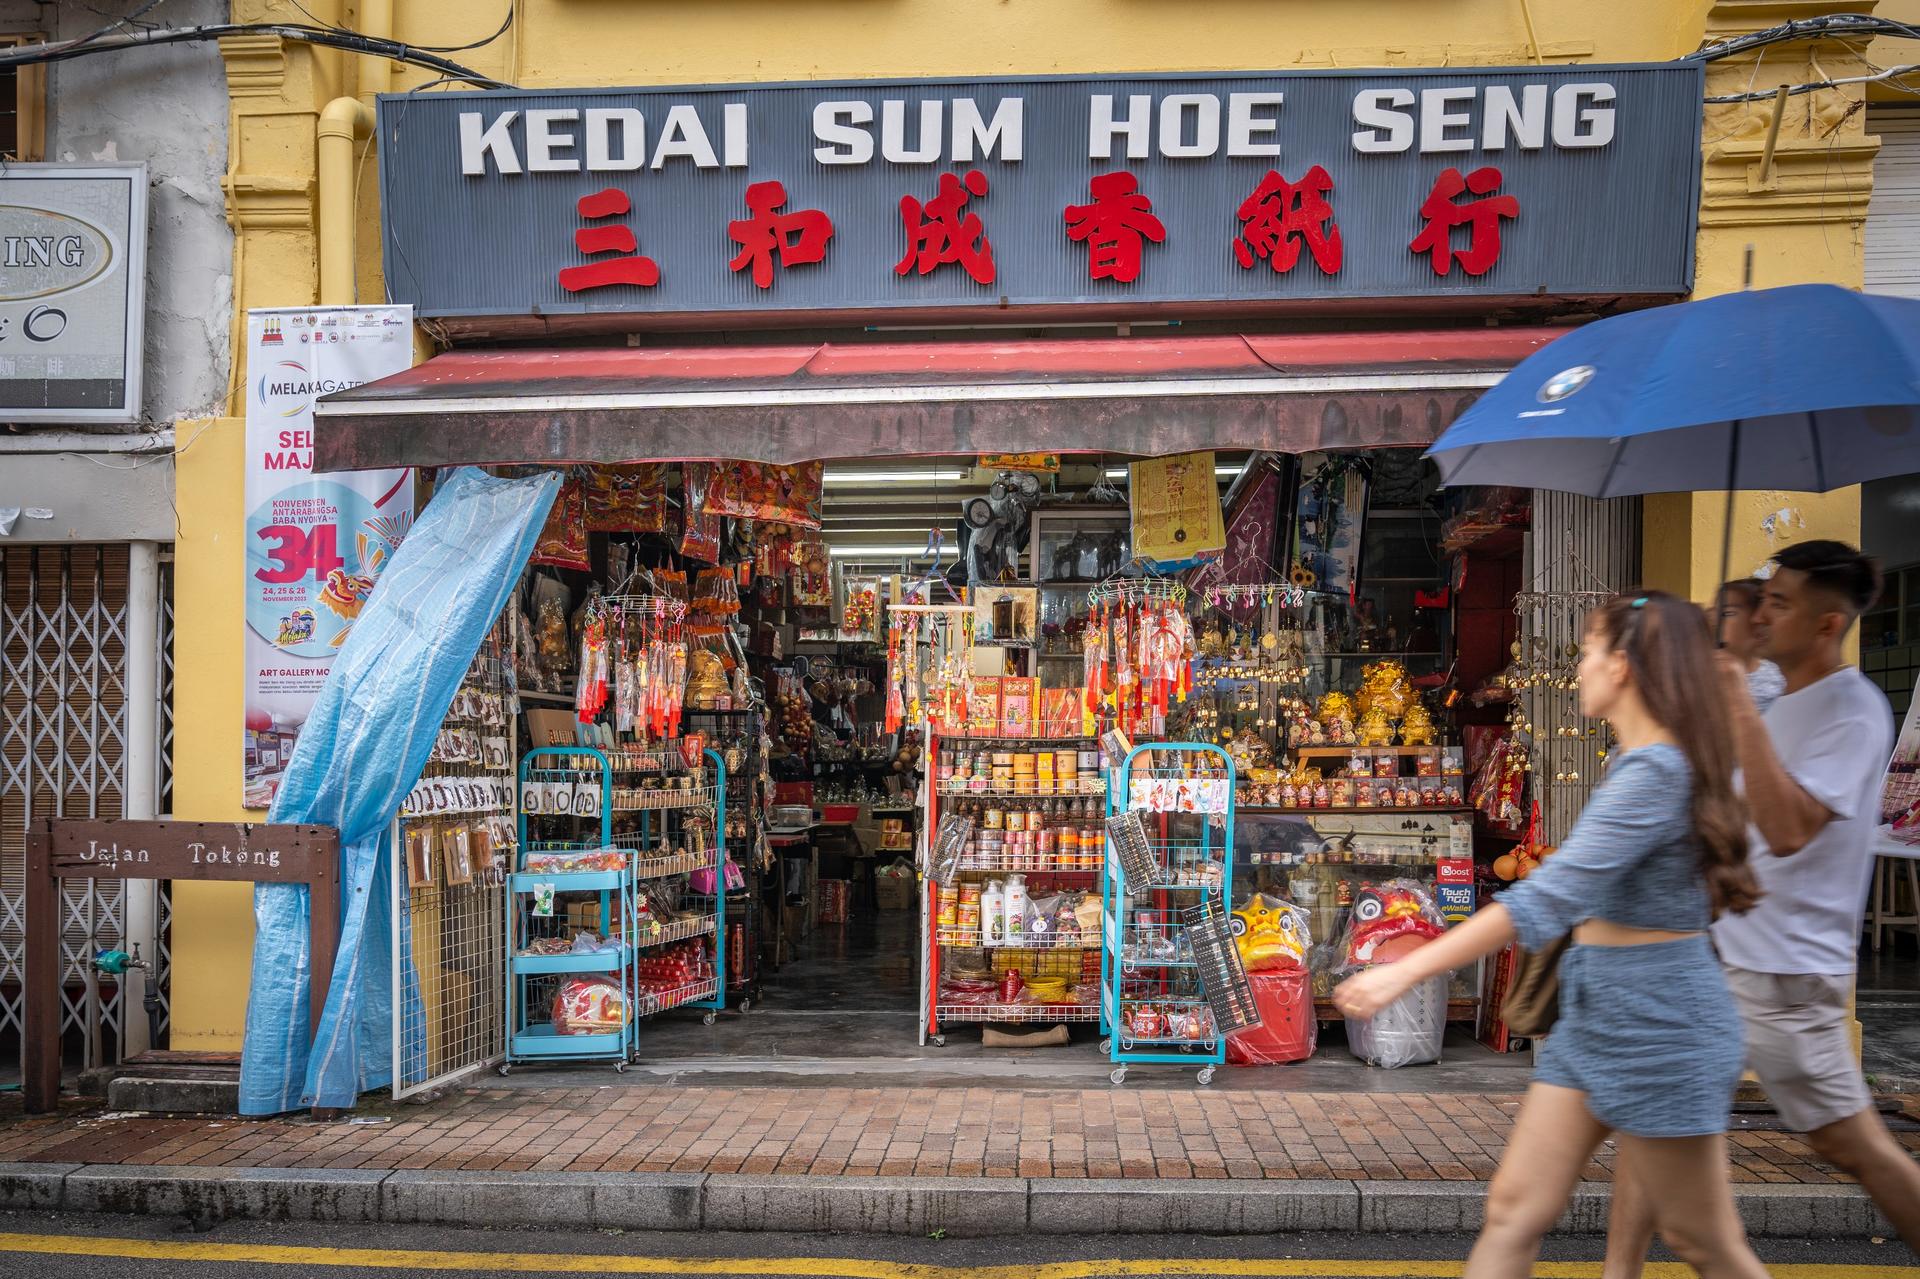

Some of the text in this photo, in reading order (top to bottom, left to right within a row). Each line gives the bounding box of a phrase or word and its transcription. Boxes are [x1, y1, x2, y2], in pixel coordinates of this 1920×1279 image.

[459, 82, 1617, 175] KEDAI SUM HOE SENG
[558, 164, 1520, 292] 三和成香紙行
[3, 236, 85, 267] ING
[270, 379, 370, 395] MELAKAGATE
[279, 430, 314, 449] SEL
[264, 452, 314, 470] MAJ
[272, 498, 326, 508] KONVENSYEN
[272, 506, 338, 516] ANTARABANGSA
[272, 516, 296, 525] BABA
[298, 515, 328, 524] NYONYA
[254, 523, 345, 584] 34
[262, 587, 276, 595] 24,
[259, 669, 278, 677] ART
[279, 669, 315, 677] GALLERY
[80, 840, 280, 869] Jalan Tokong
[1441, 888, 1471, 896] Touch
